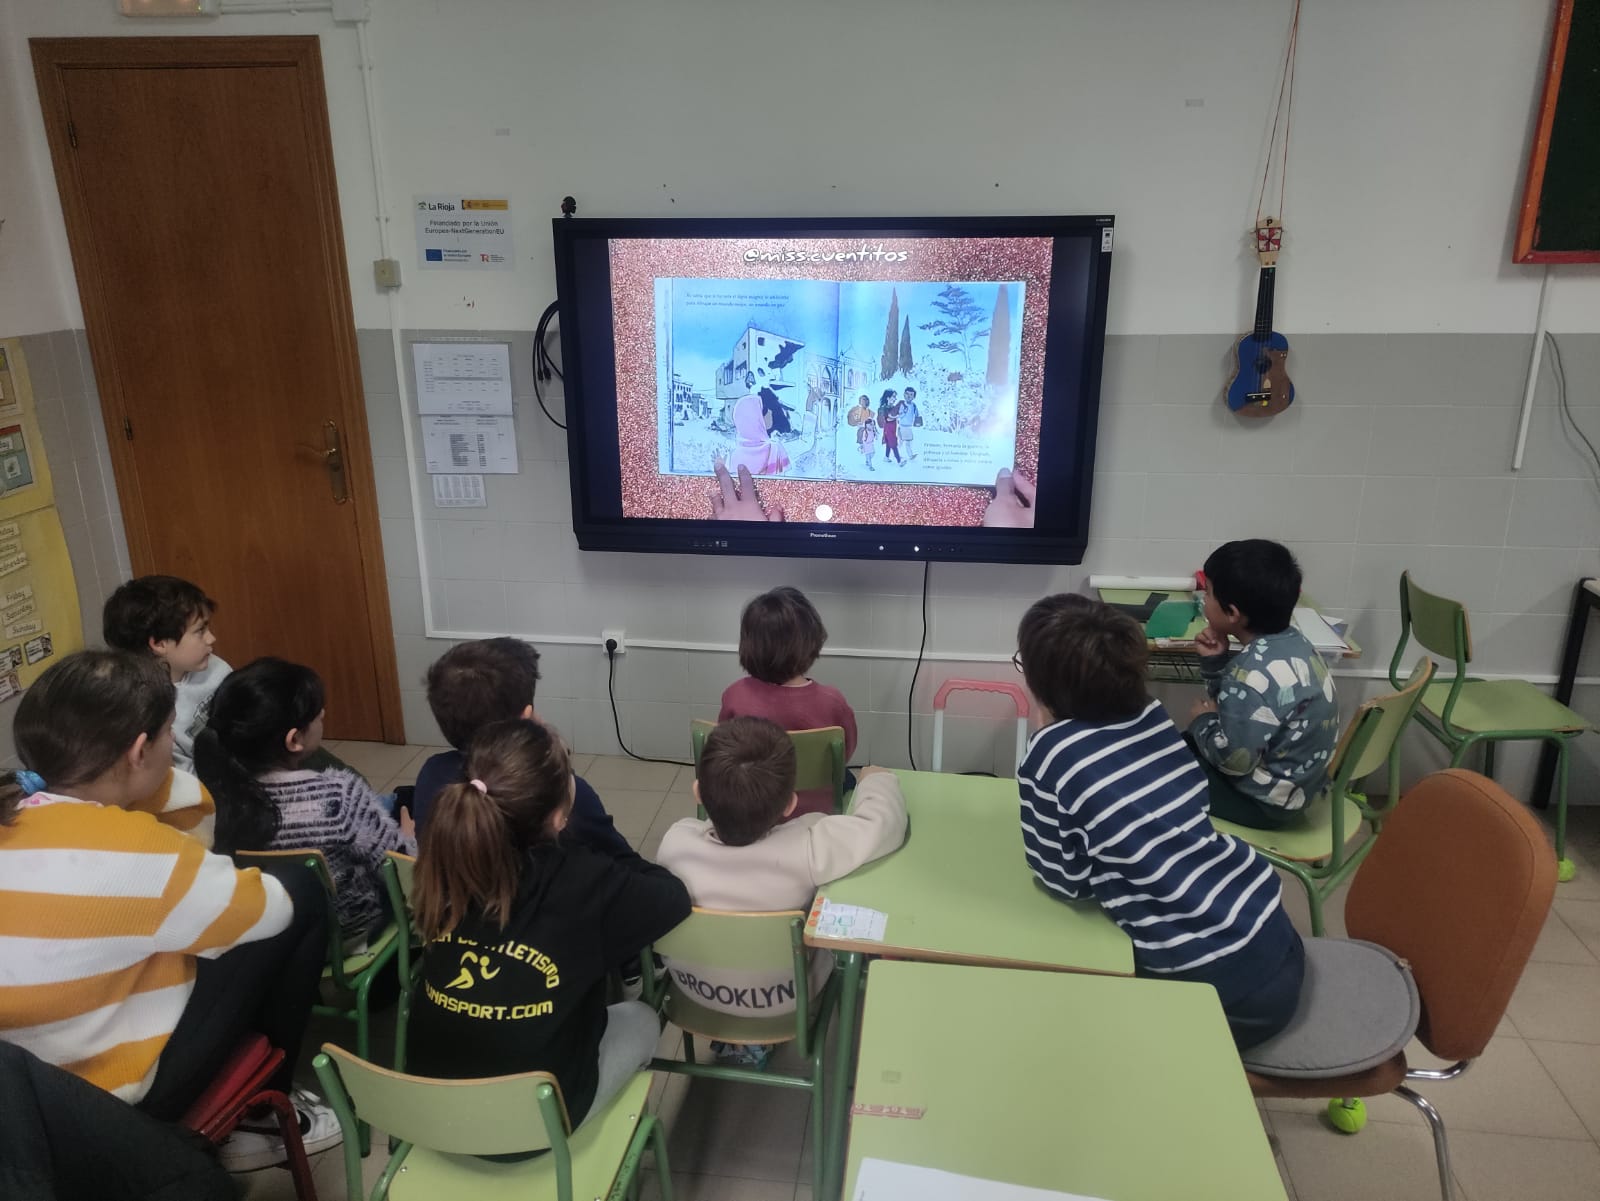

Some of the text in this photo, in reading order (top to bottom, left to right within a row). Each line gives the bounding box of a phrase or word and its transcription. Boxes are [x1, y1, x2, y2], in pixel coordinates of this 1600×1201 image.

[428, 203, 437, 211] La
[437, 203, 455, 212] Rioja
[674, 968, 796, 1009] BROOKLYN
